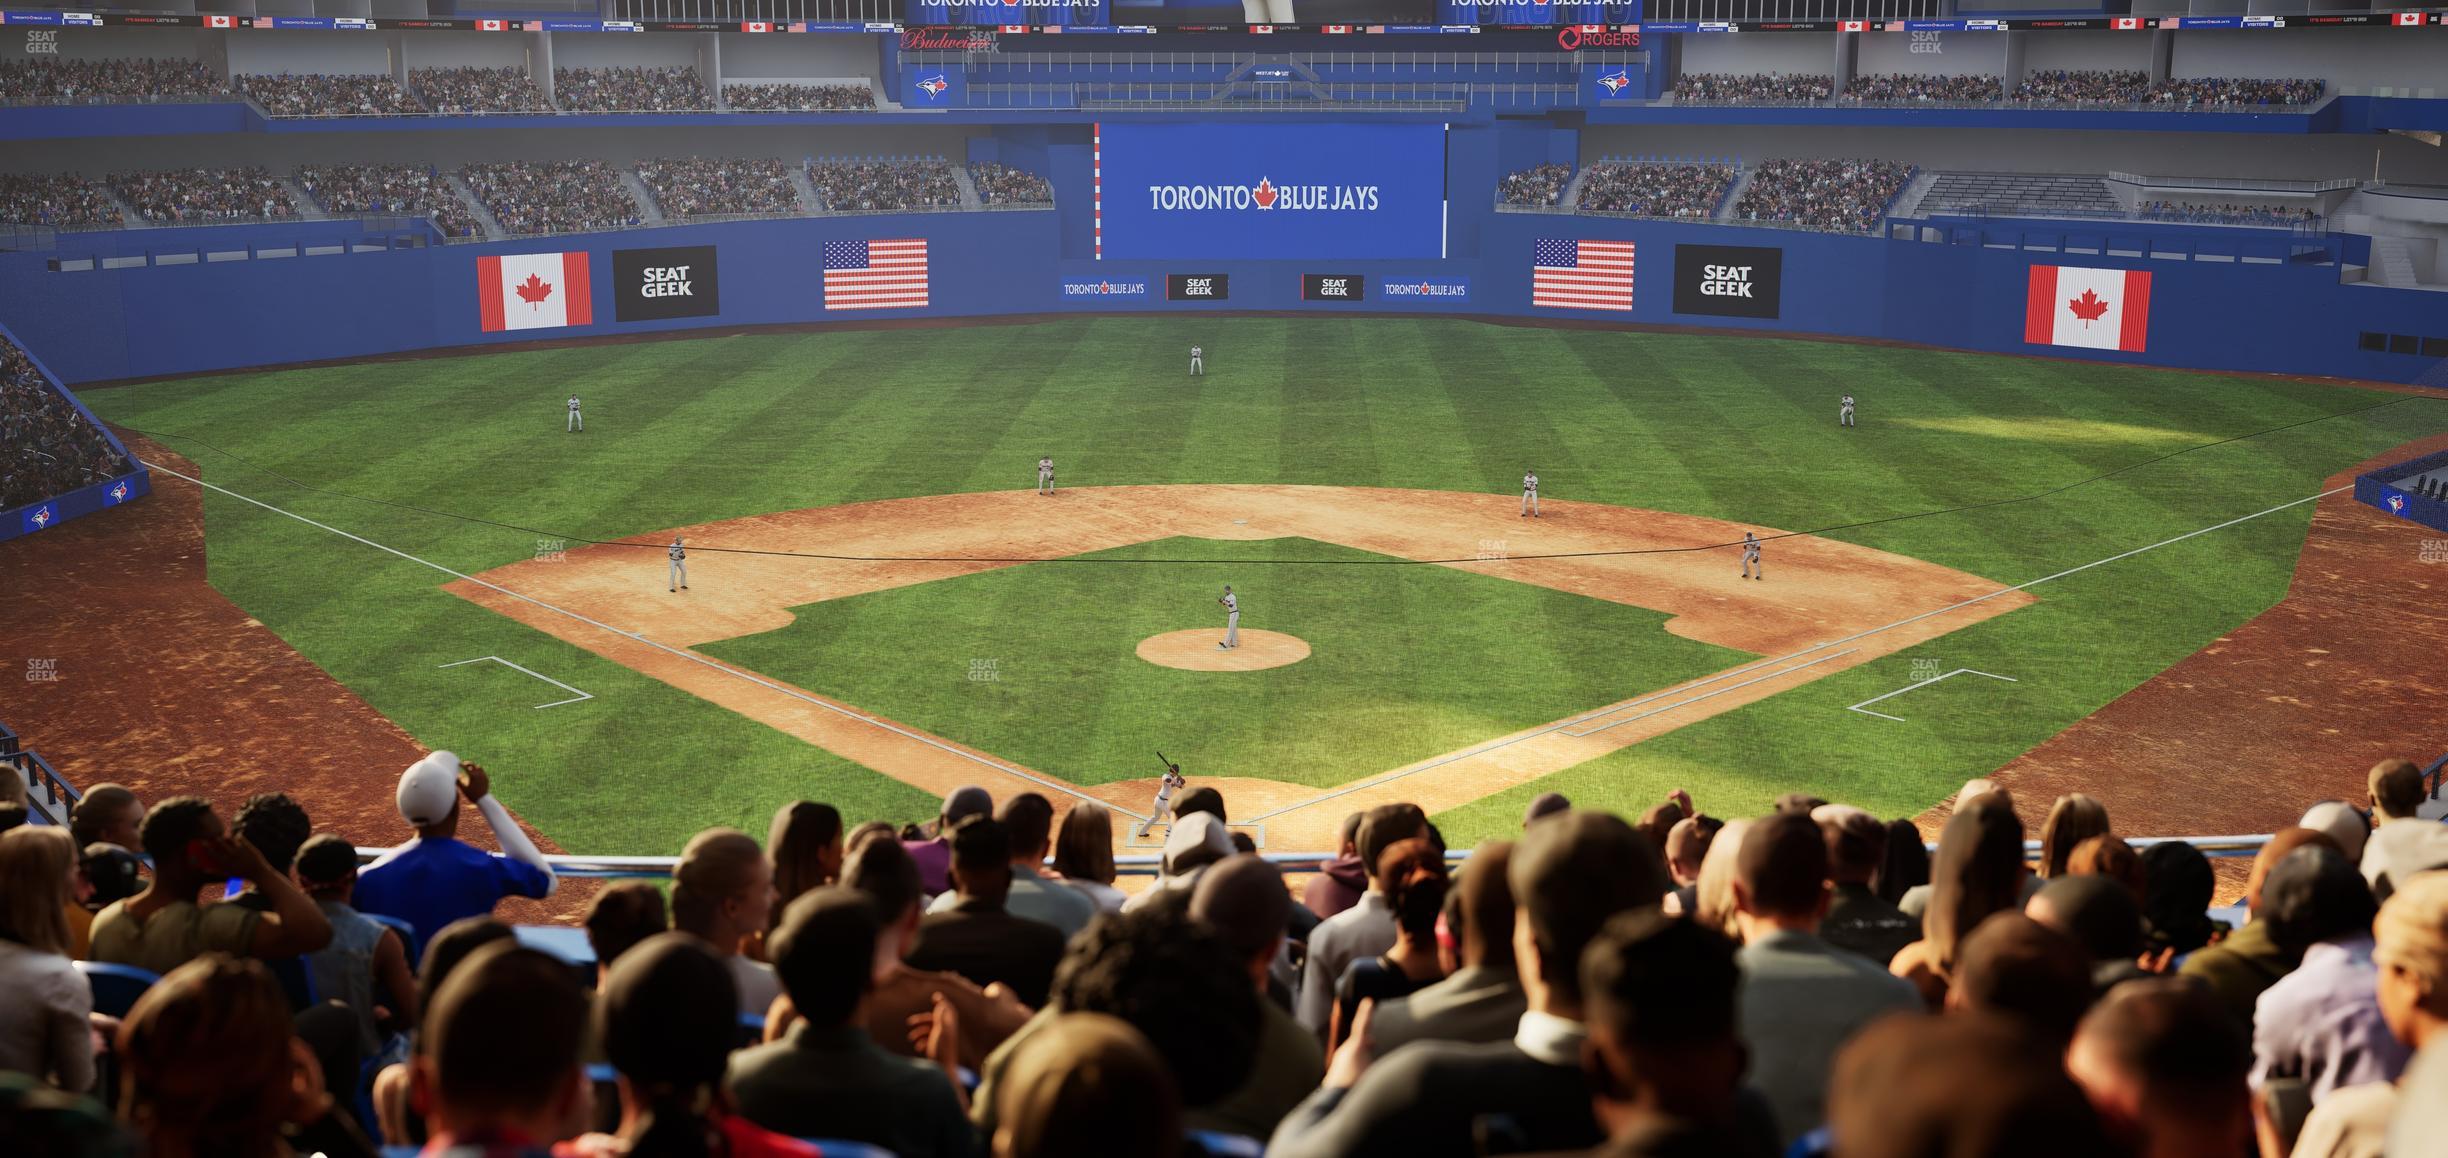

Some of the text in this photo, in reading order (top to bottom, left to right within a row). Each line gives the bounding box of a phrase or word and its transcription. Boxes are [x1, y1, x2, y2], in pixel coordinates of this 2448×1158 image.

[1583, 33, 1639, 46] ROGERS
[1150, 185, 1379, 211] TORONTO BLUE JAYS
[643, 265, 690, 283] SEAT
[1704, 264, 1752, 281] SEAT
[1187, 278, 1212, 287] SEAT
[1322, 278, 1347, 287] SEAT
[641, 281, 693, 298] GEEK
[1065, 283, 1145, 295] TORONTO BLUE JAYS
[1185, 287, 1213, 296] GEEK
[1321, 287, 1348, 297] GEEK
[1385, 284, 1465, 296] TORONTO BLUE JAYS
[1700, 280, 1753, 298] GEEK
